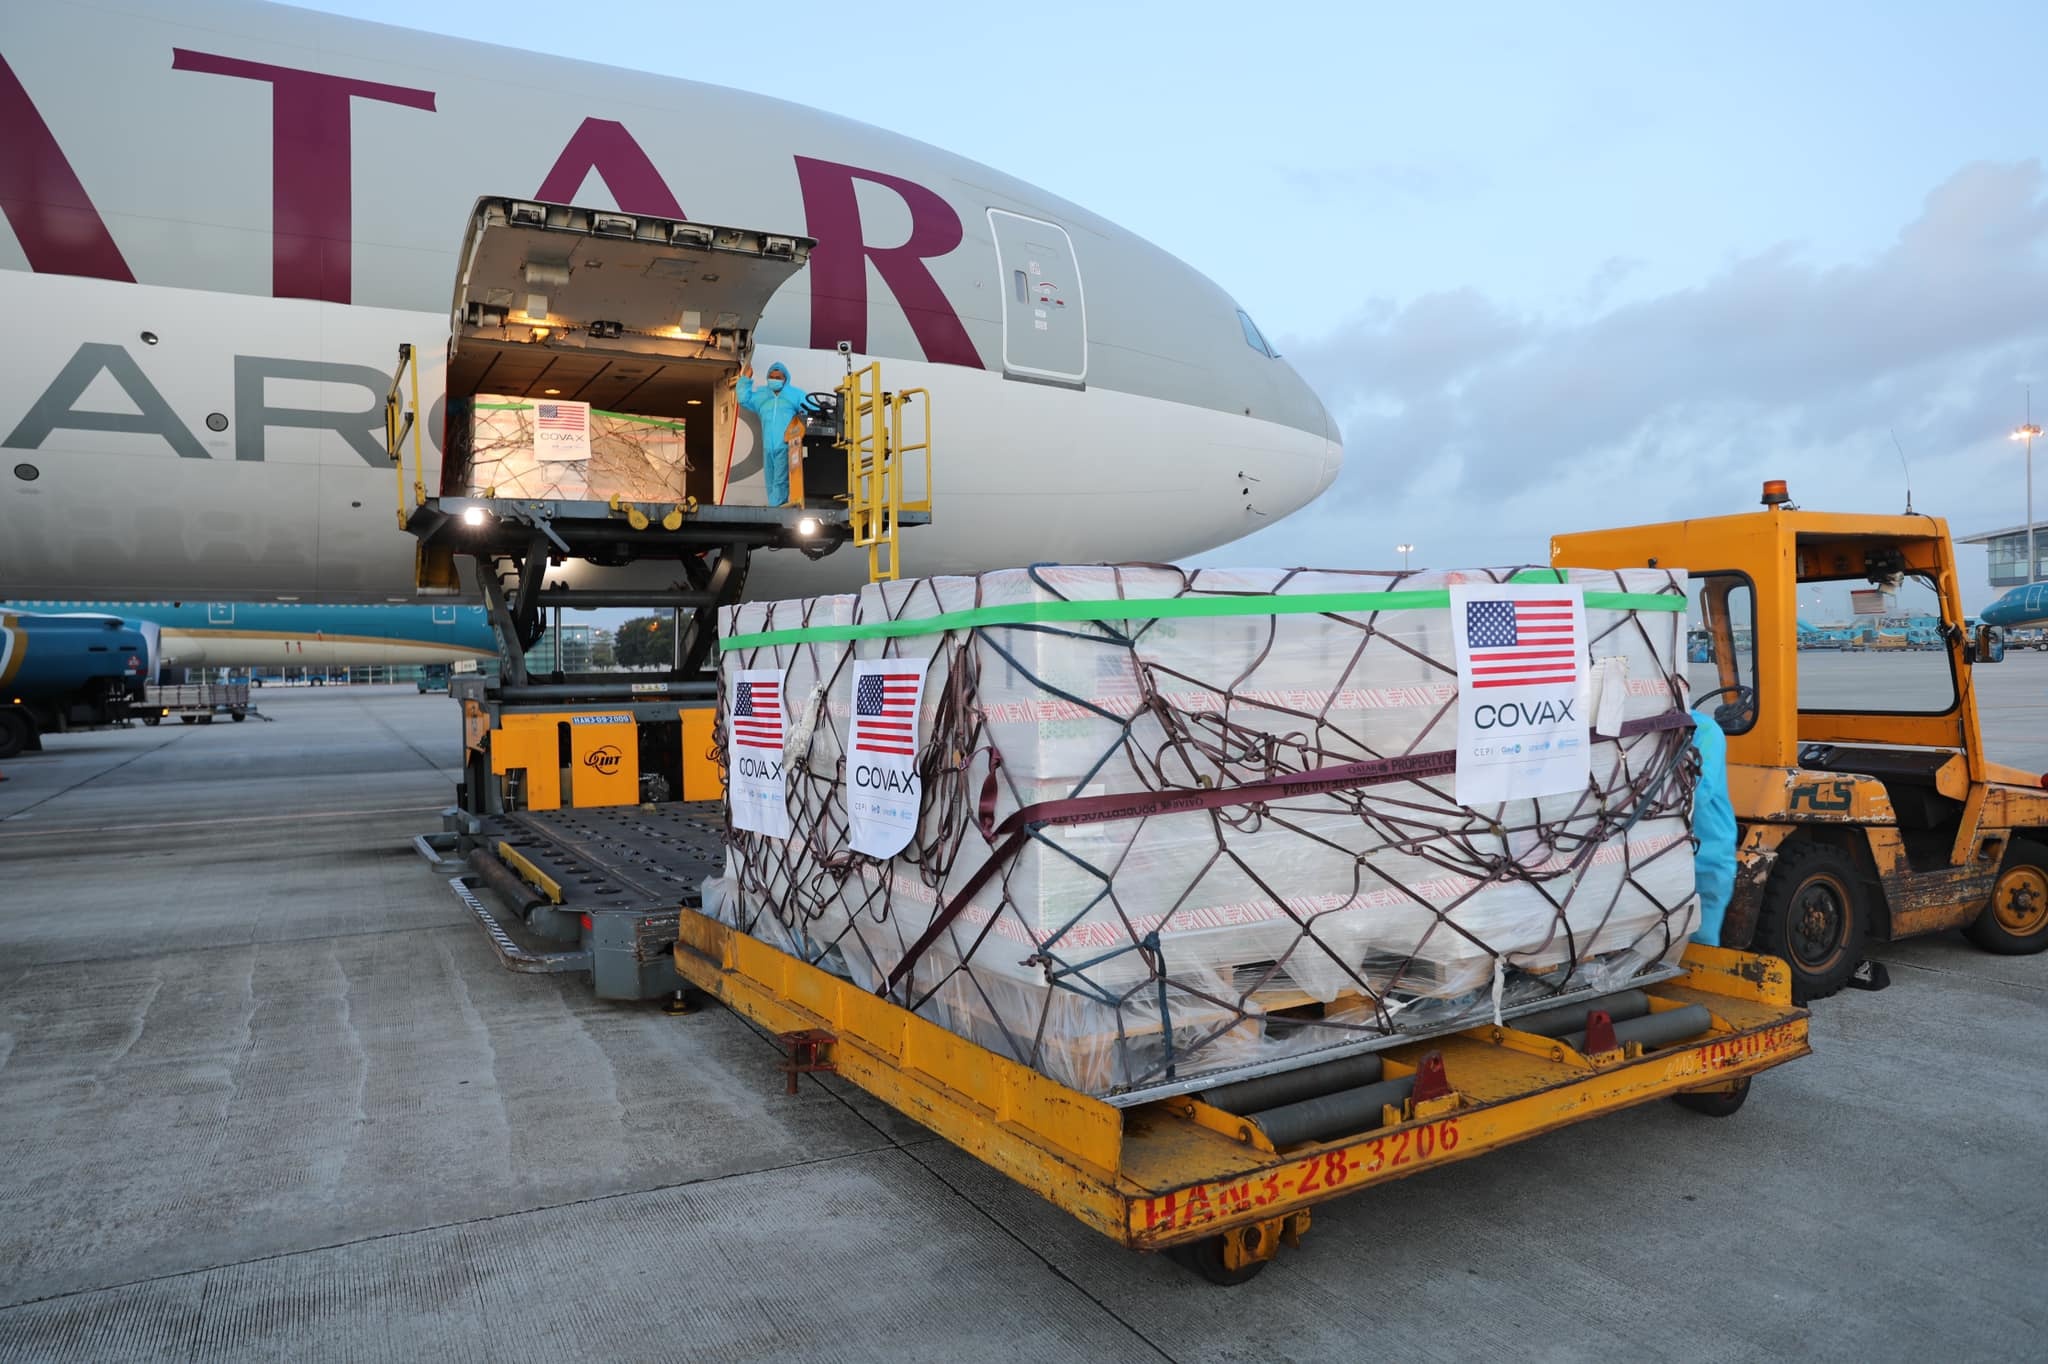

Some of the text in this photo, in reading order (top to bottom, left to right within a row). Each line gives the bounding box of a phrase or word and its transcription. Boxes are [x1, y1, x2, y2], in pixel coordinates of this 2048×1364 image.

[540, 432, 585, 442] COVAX
[1474, 699, 1575, 729] COVAX
[739, 757, 783, 780] COVAX
[1347, 765, 1377, 775] QATAR
[1391, 755, 1443, 772] PROPERTY
[855, 765, 914, 795] COVAX
[1145, 1117, 1459, 1230] HAN3-28-3206
